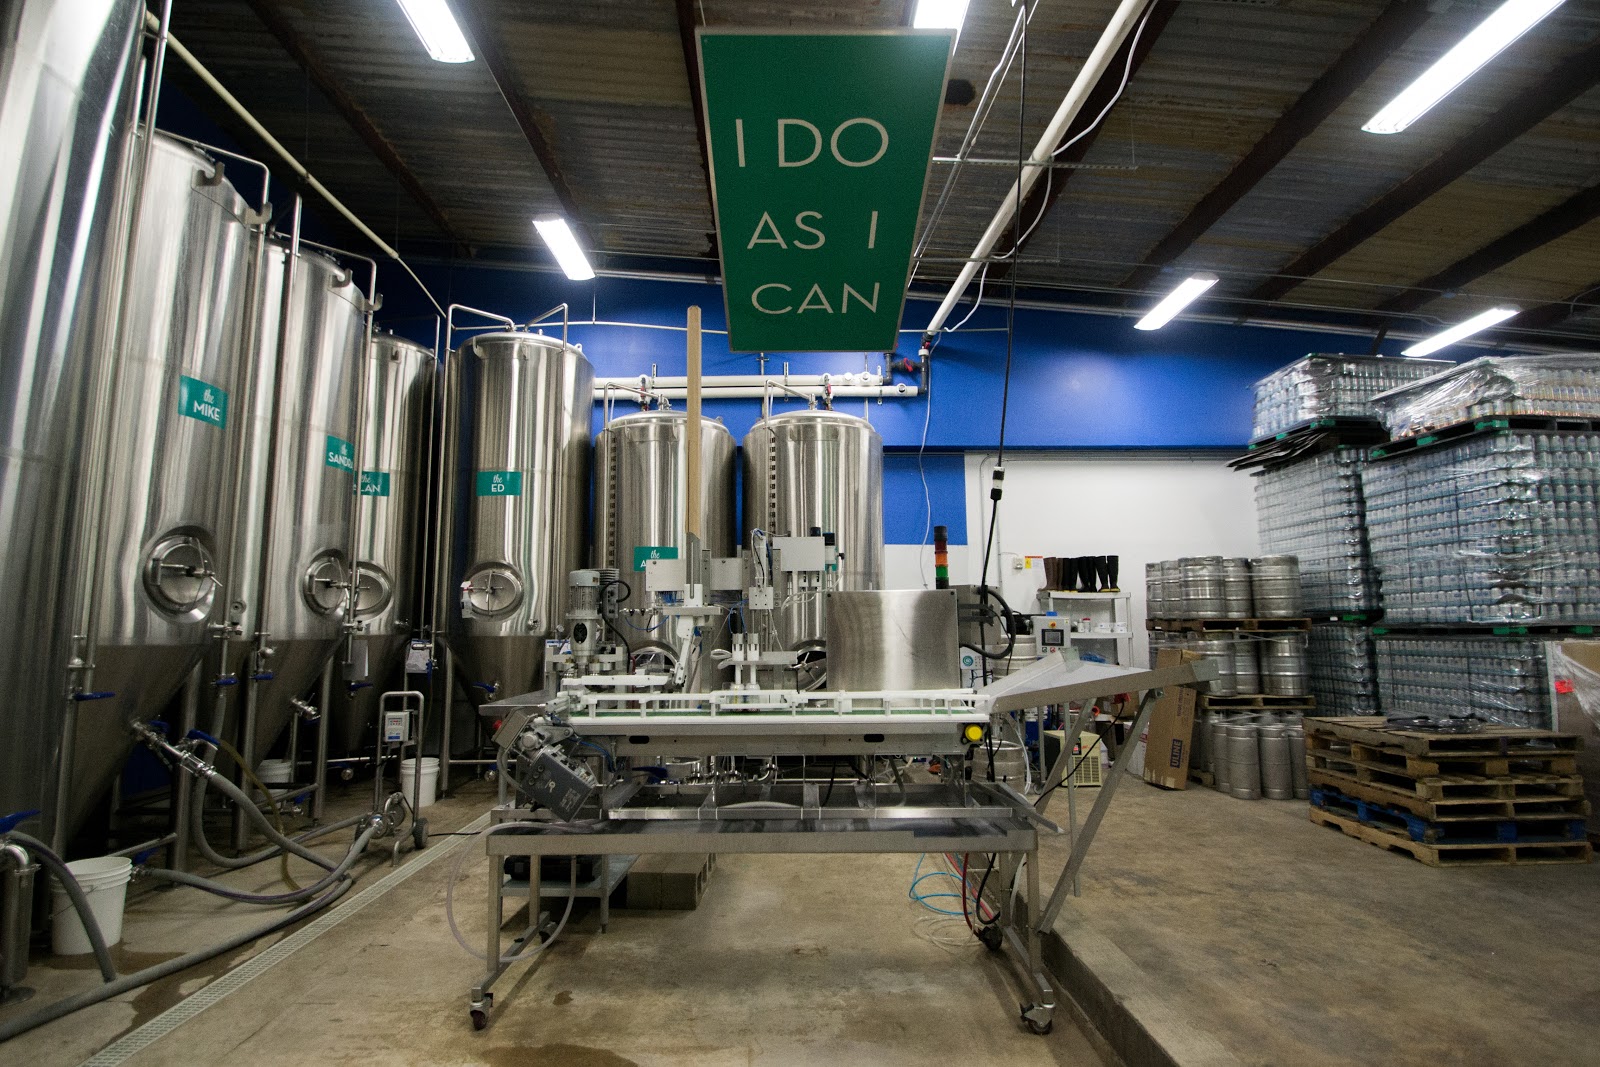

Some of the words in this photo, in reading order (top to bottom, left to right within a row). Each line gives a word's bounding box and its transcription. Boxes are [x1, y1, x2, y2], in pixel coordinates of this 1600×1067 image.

[735, 118, 746, 168] I
[777, 117, 889, 168] DO
[747, 210, 826, 250] AS
[868, 211, 878, 249] I
[751, 281, 880, 315] CAN
[193, 400, 221, 422] MIKE
[491, 484, 505, 493] ED
[493, 474, 503, 484] the
[650, 549, 660, 559] the
[1171, 740, 1182, 766] ULINE
